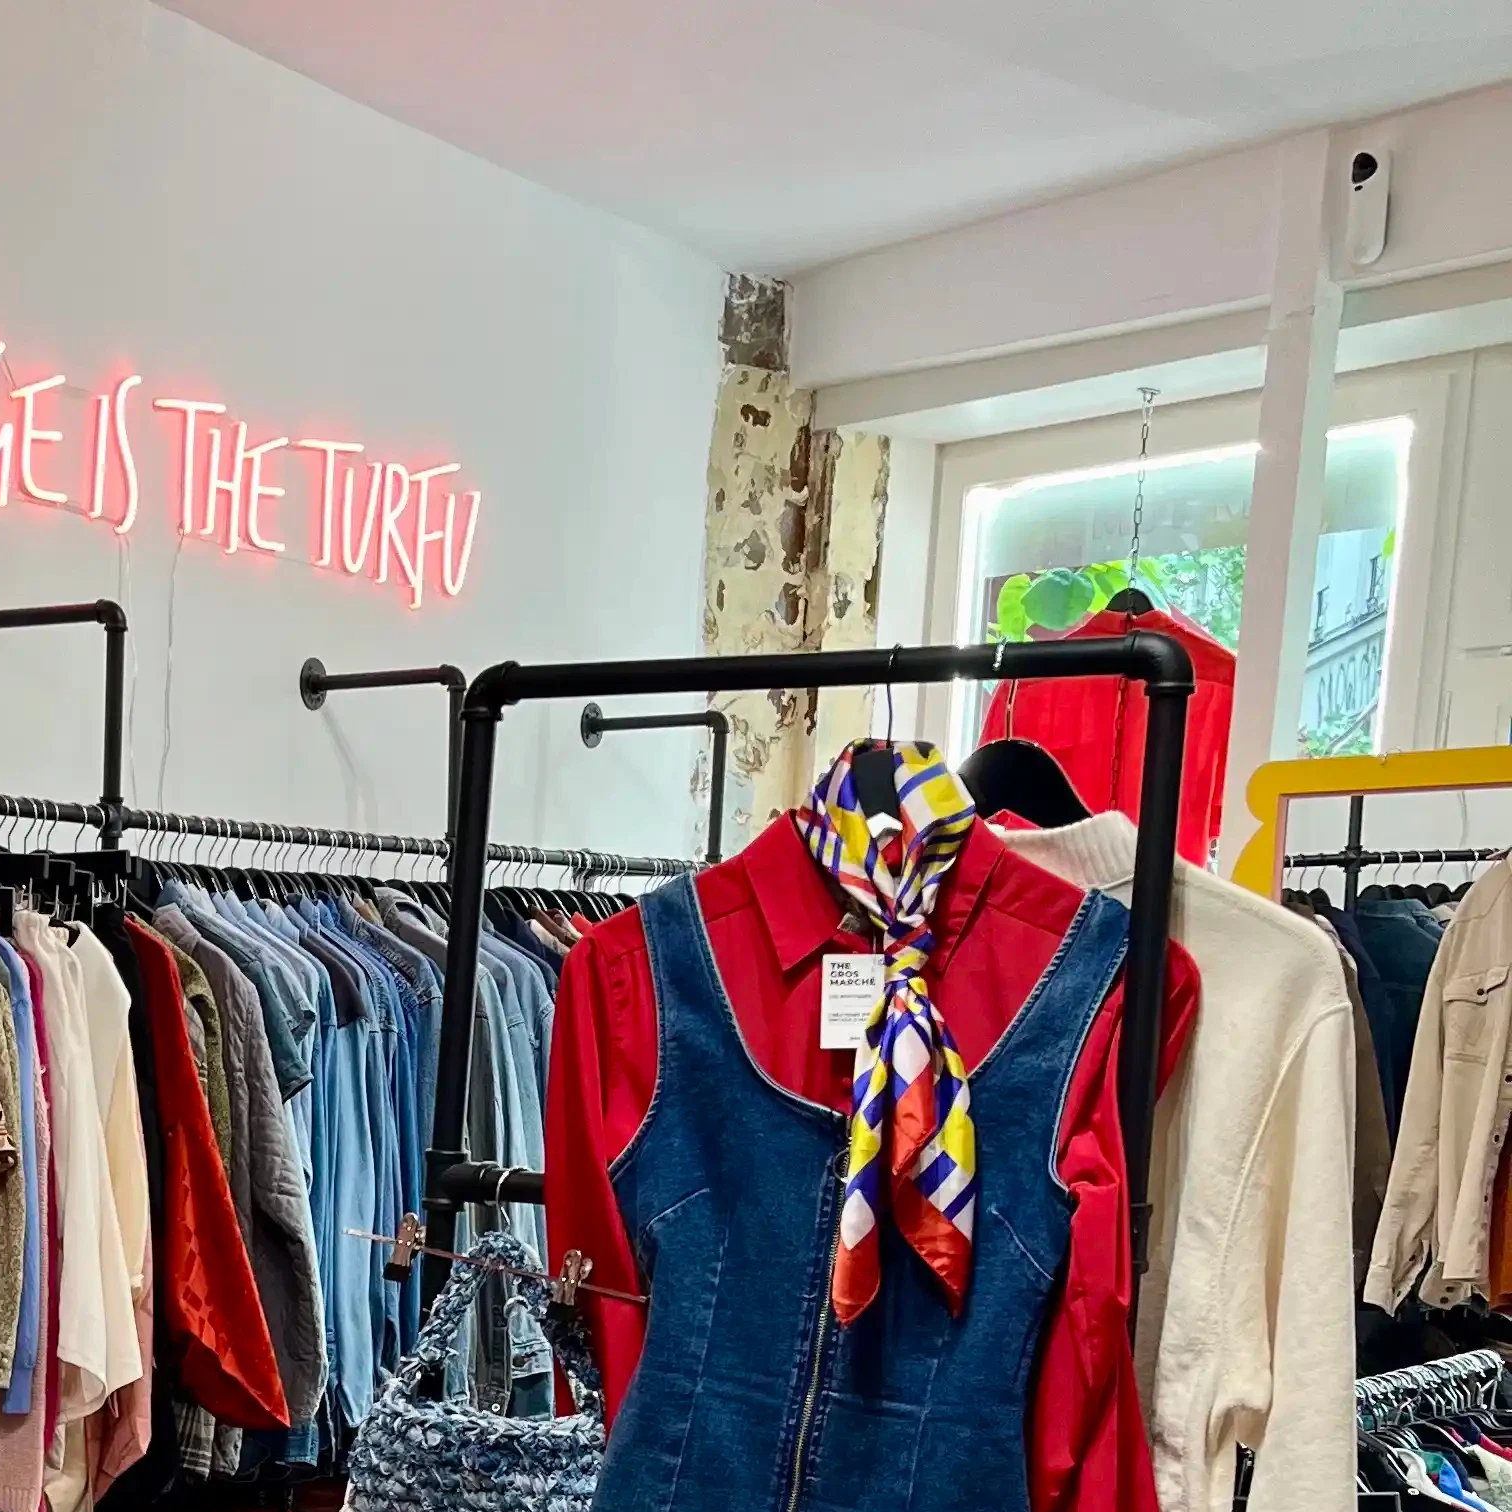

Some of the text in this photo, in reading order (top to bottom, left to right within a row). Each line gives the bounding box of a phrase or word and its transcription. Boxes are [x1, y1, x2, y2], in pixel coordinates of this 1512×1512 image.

[88, 374, 143, 534] IS
[152, 397, 289, 556] THE
[292, 438, 482, 610] TURFU
[830, 962, 851, 970] THE
